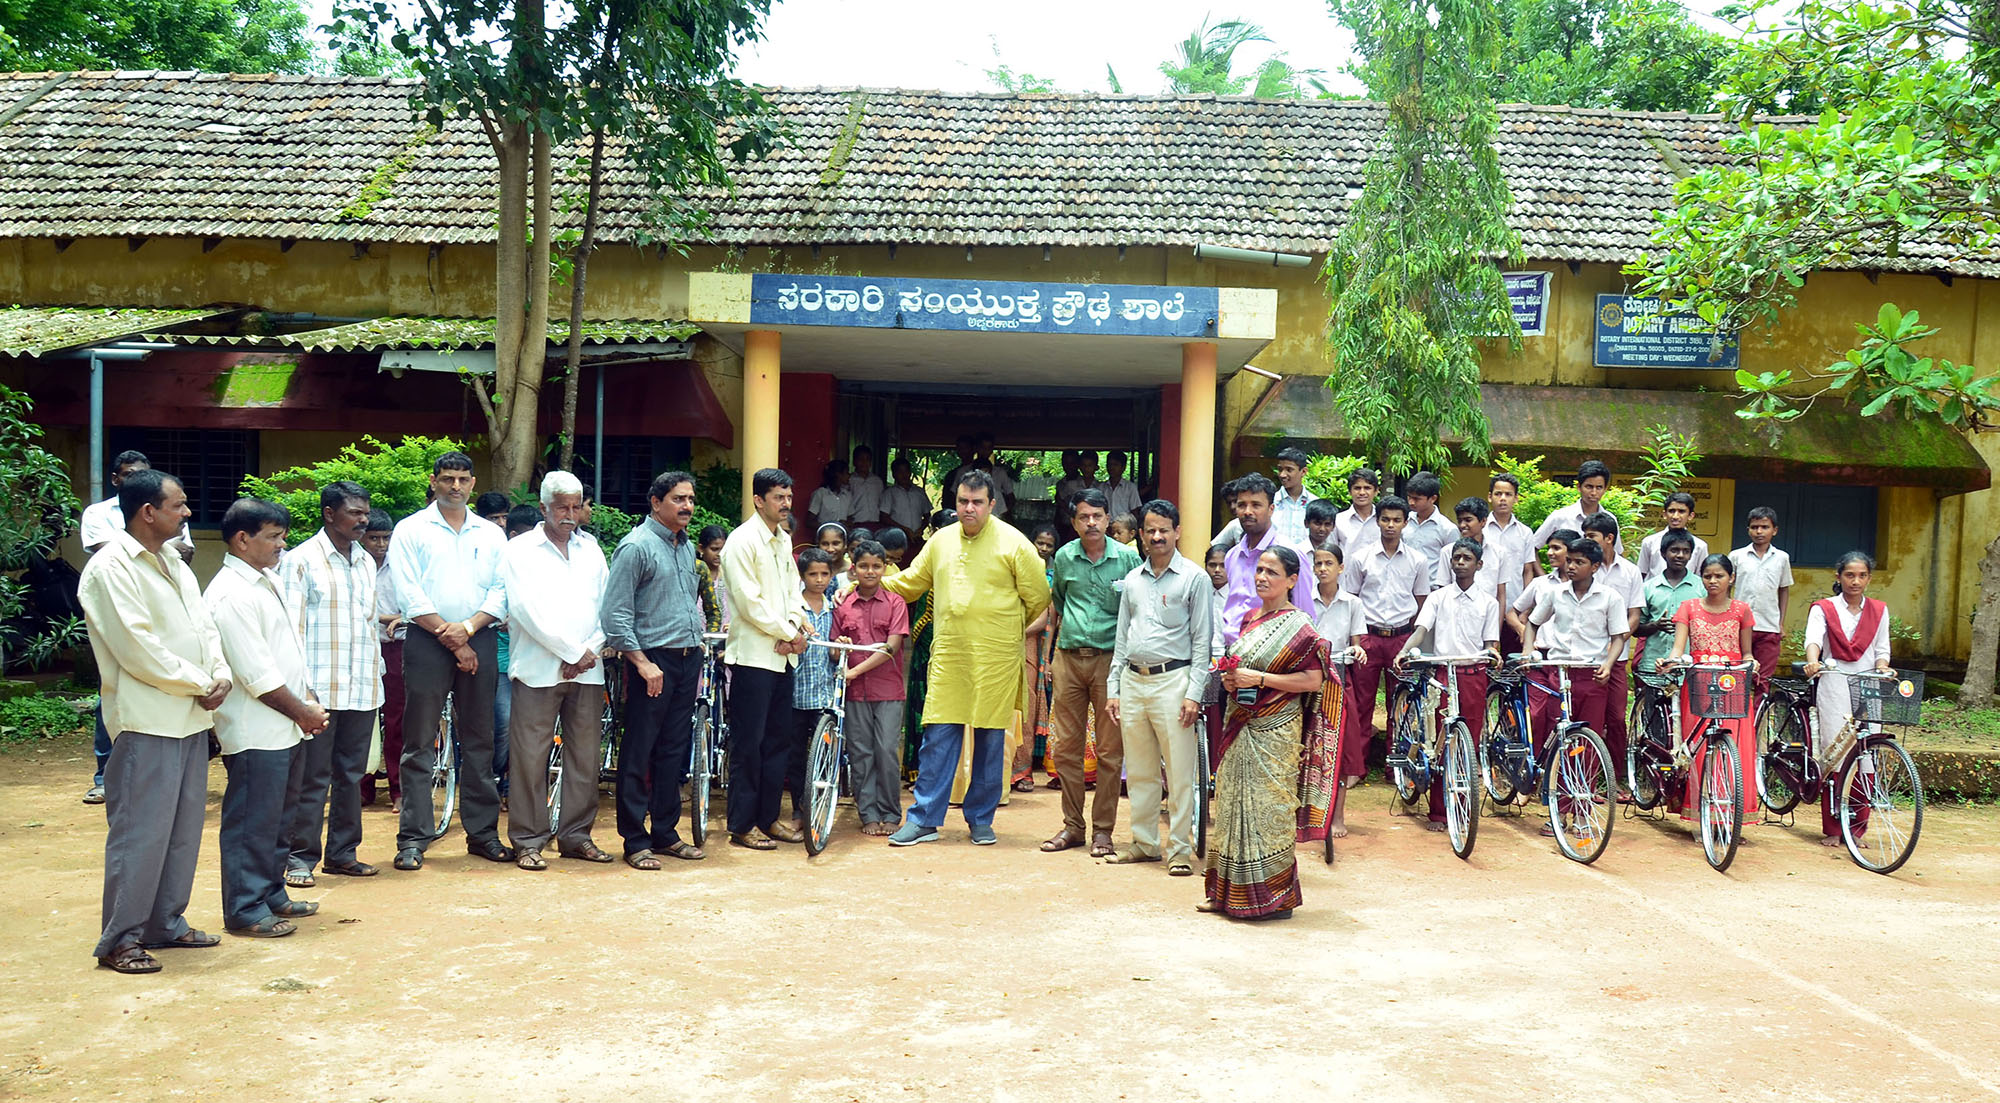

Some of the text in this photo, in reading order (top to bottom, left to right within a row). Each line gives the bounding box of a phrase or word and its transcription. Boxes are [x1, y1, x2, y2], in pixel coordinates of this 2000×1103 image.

[778, 282, 1185, 327] ಸರಕಾರಿ ಸಂಯುಕ್ತ ಪ್ರೌಢ ಶಾಲೆ
[1600, 335, 1620, 343] ROTARY
[1663, 336, 1687, 344] DISTRICT
[1622, 353, 1648, 361] MEETING
